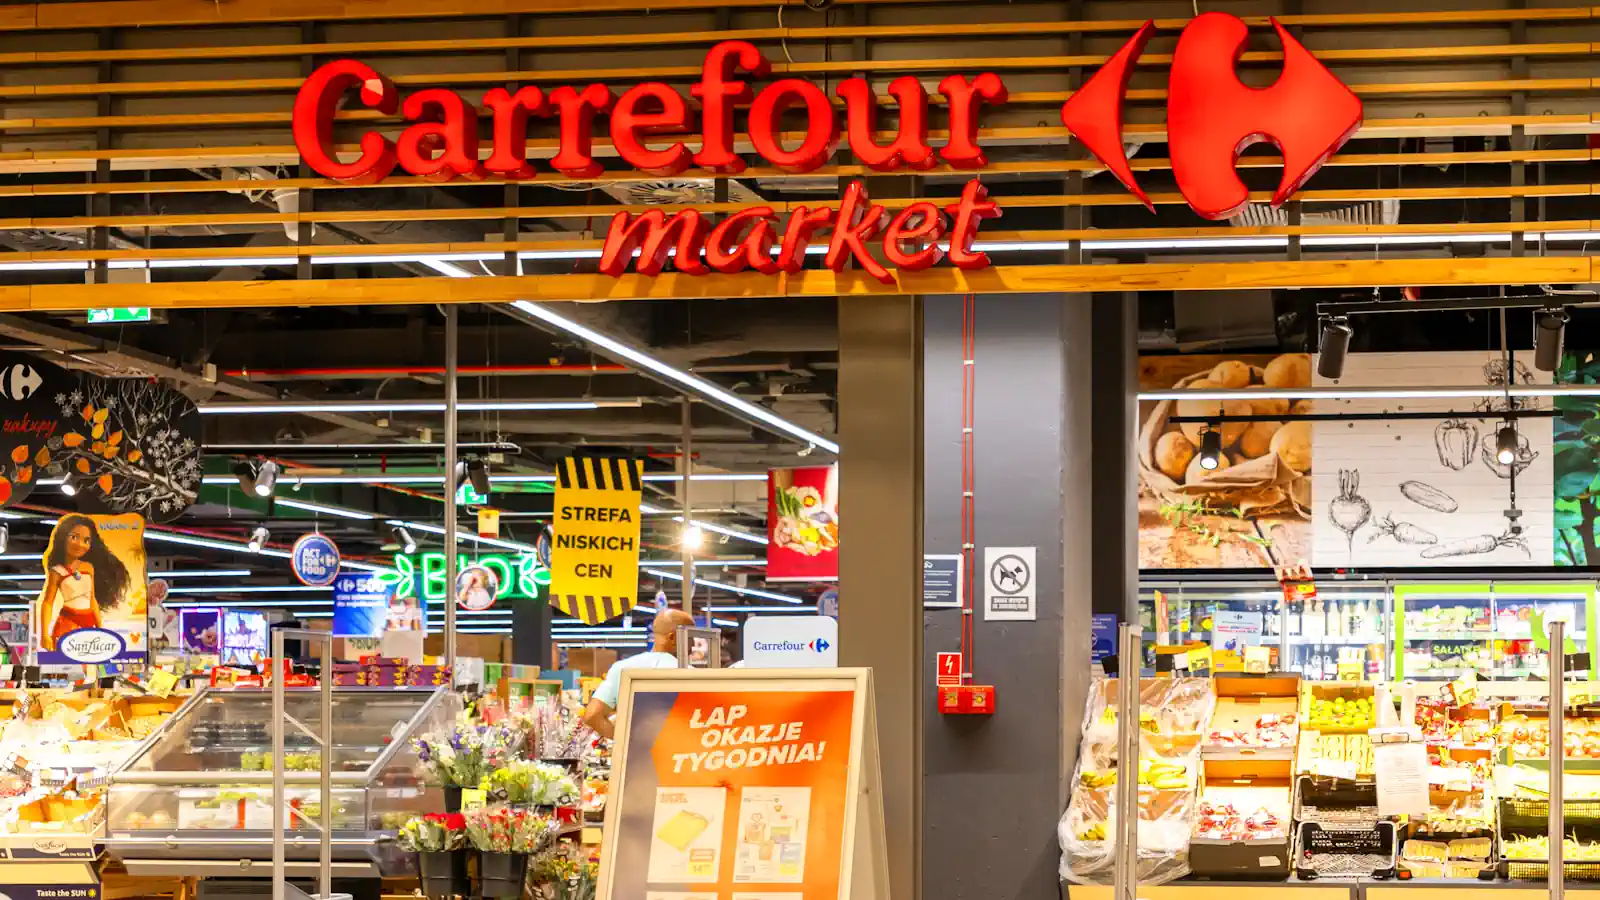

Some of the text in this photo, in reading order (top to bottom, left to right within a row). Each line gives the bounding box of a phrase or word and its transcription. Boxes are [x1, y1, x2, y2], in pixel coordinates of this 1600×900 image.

[292, 39, 1009, 186] Carrefour
[599, 179, 1004, 285] market
[561, 506, 632, 523] STREFA
[557, 534, 634, 551] NISKICH
[302, 566, 326, 575] FOOD
[574, 563, 613, 579] CEN
[66, 636, 117, 657] SanLucar
[753, 640, 806, 651] Carrefour
[689, 704, 748, 729] ŁAP
[700, 721, 804, 749] OKAZJE
[672, 741, 827, 773] TYGODNIA!
[36, 889, 87, 897] Taste the SUN
